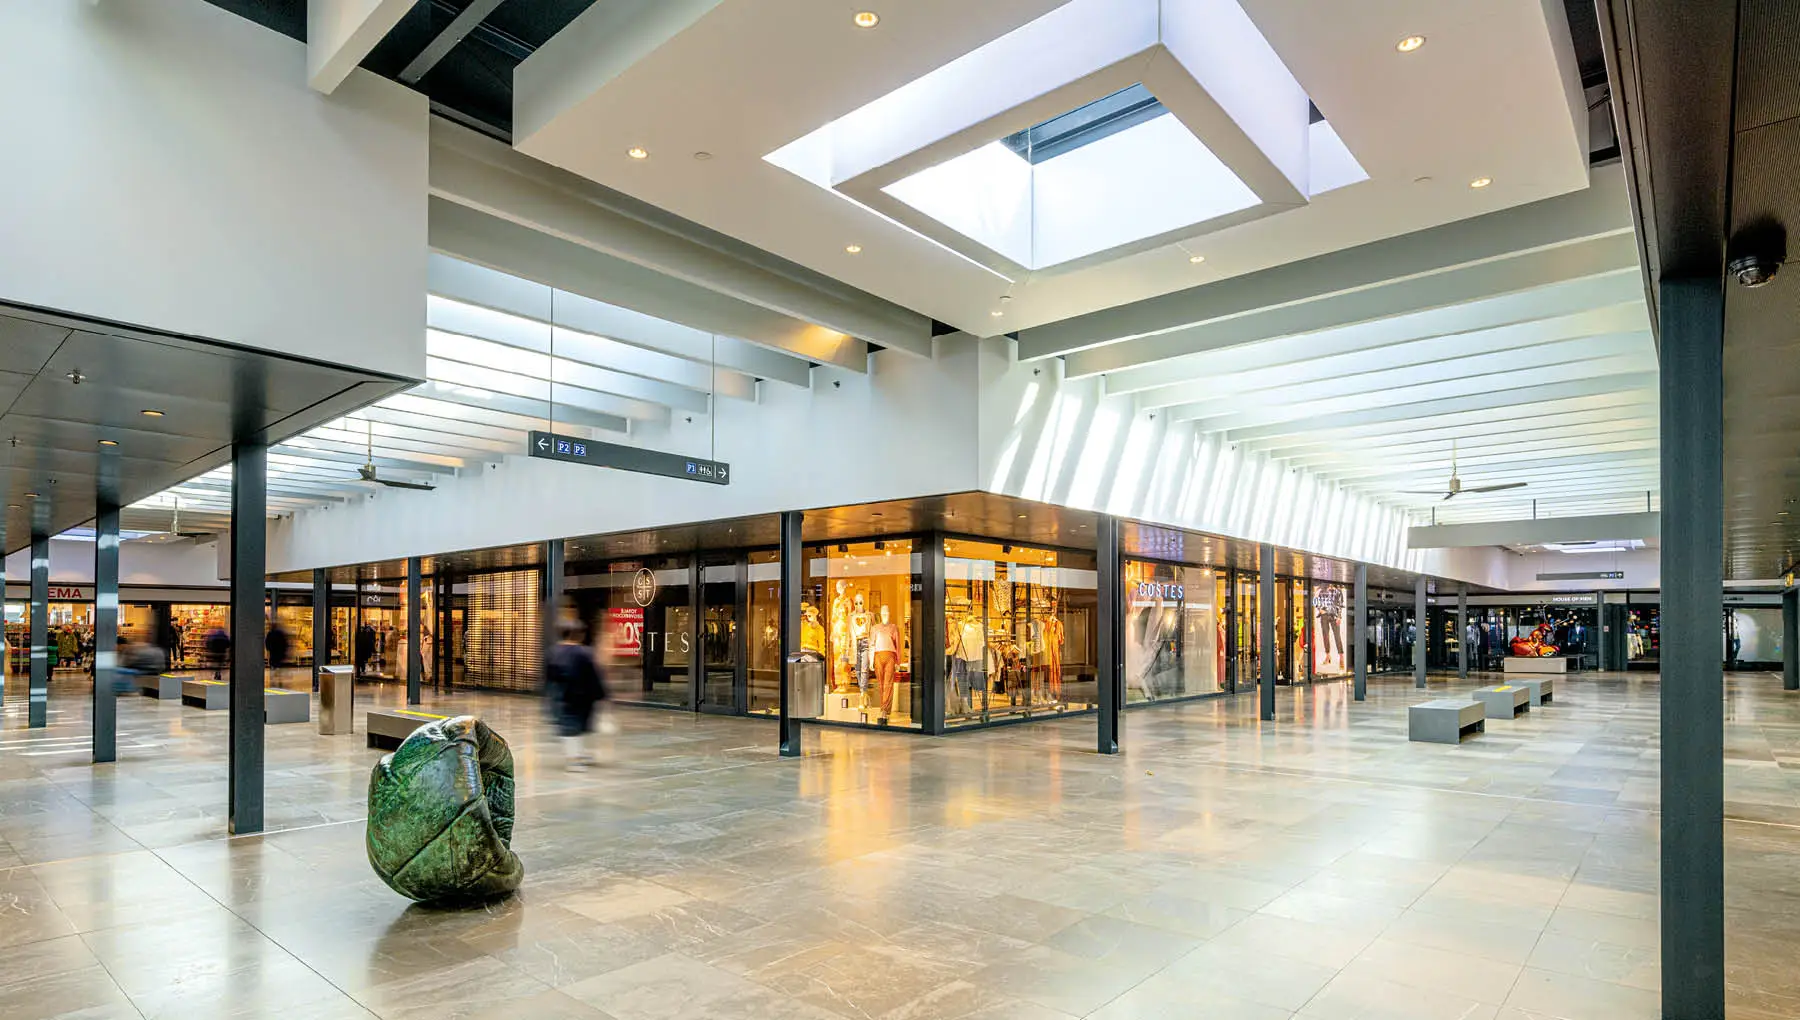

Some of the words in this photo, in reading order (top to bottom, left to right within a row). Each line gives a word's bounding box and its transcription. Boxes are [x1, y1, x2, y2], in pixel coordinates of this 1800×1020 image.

[559, 442, 569, 452] P2
[575, 445, 585, 455] P3
[48, 587, 82, 598] EMA
[1139, 582, 1183, 599] COSTES
